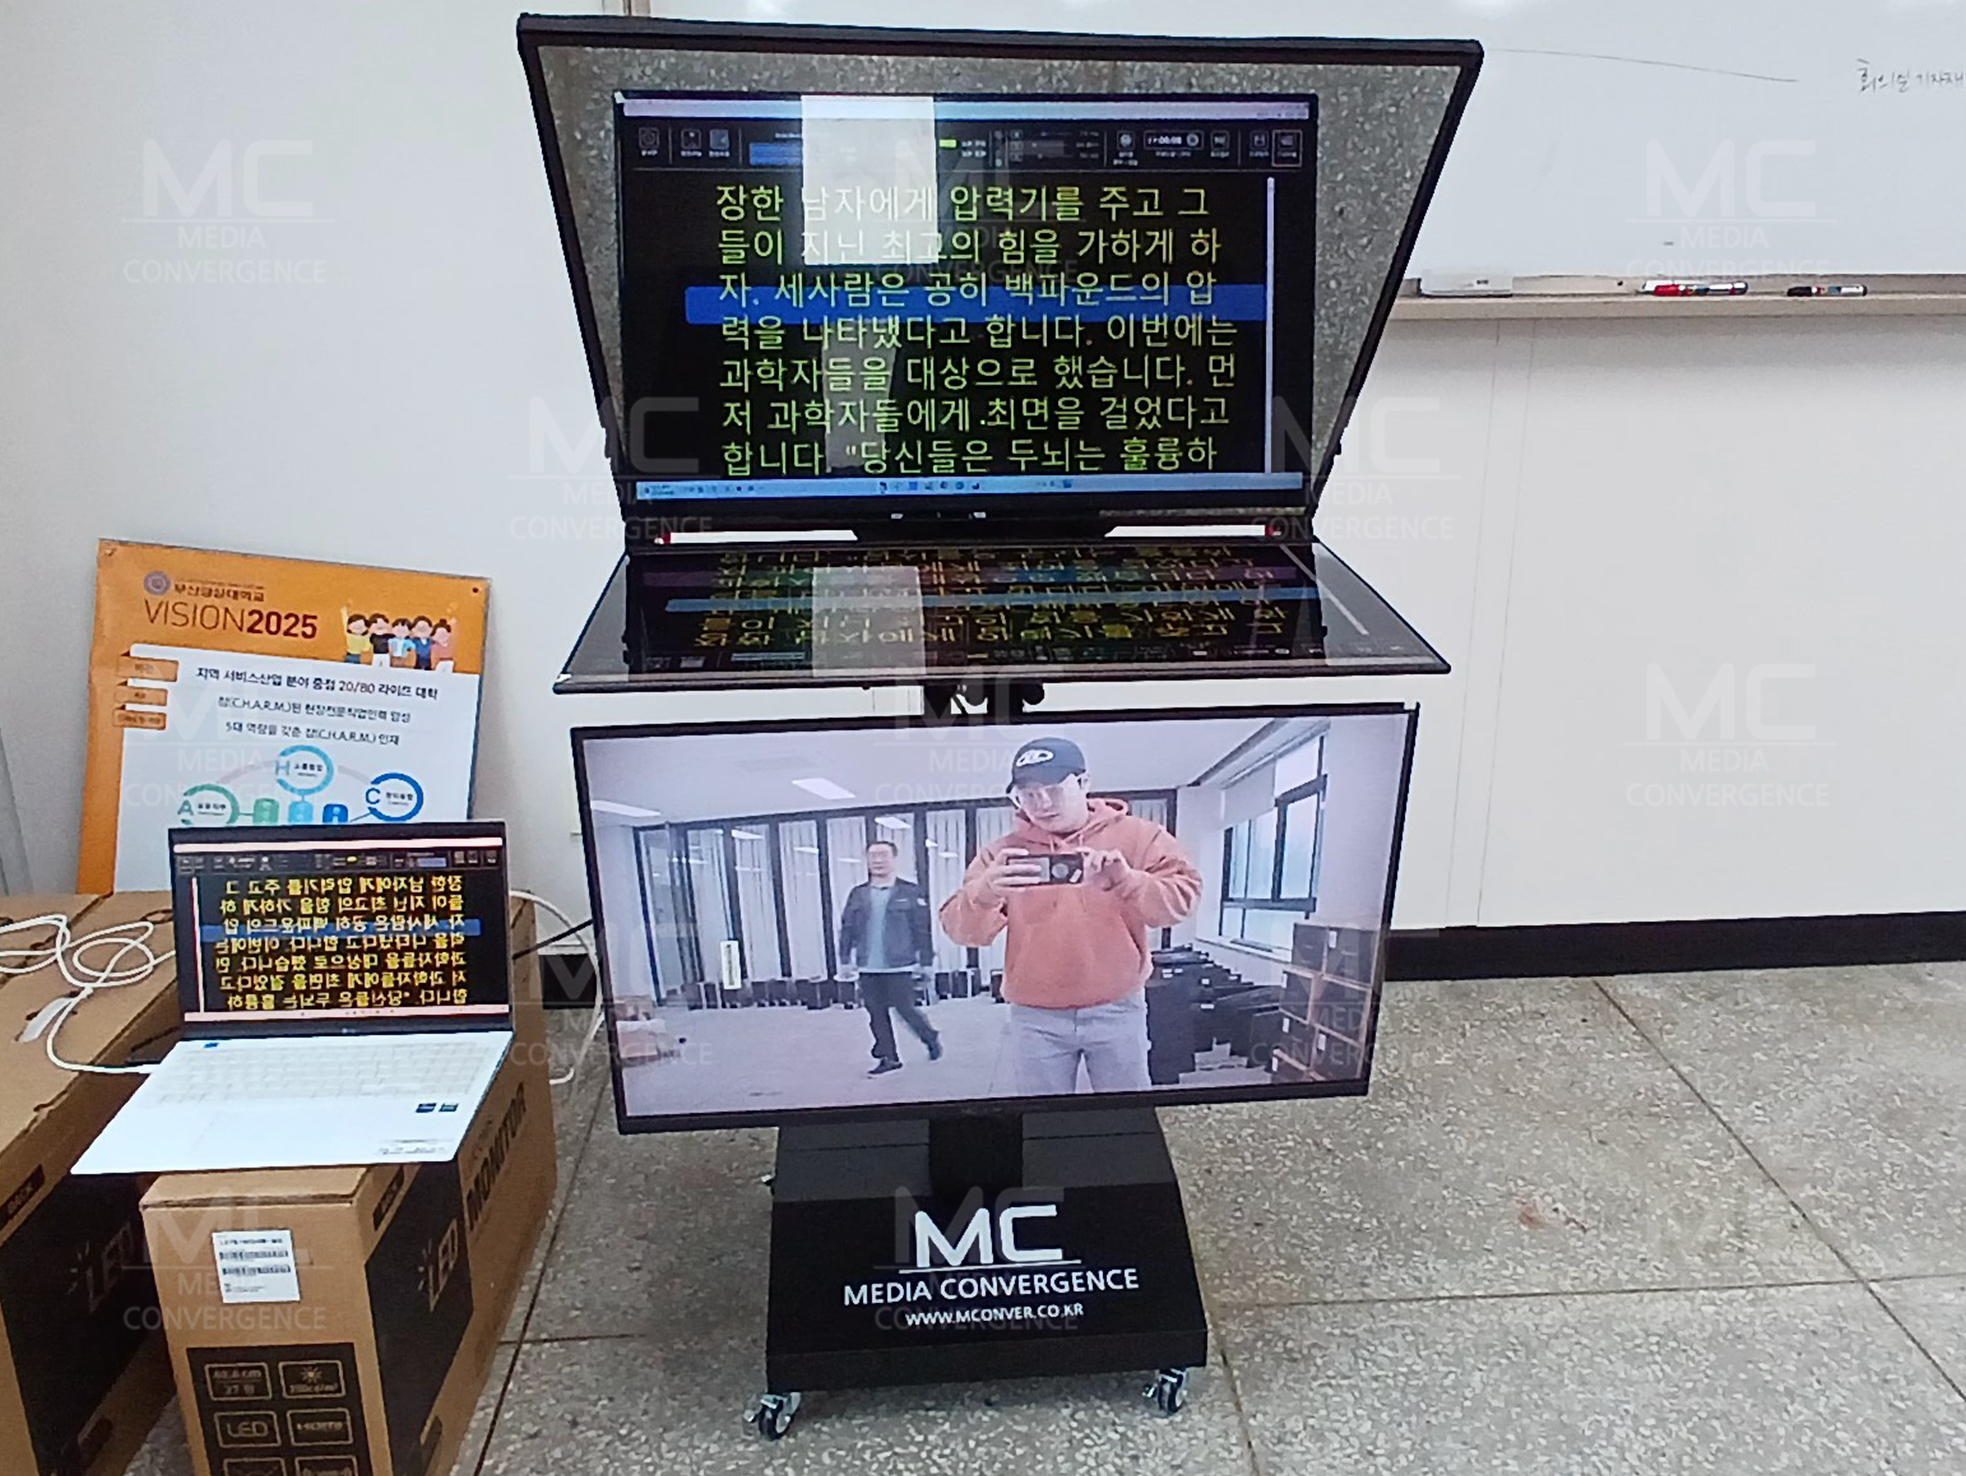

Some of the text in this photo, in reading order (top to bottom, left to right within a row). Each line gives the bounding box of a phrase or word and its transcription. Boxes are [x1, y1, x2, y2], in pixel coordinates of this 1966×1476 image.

[717, 185, 785, 221] 장한
[950, 186, 1084, 222] 압력기를
[1099, 186, 1163, 222] 주고
[1179, 189, 1208, 215] 그
[718, 228, 783, 265] 들이
[998, 229, 1060, 265] 힘을
[1078, 228, 1173, 264] 가하게
[1191, 227, 1220, 263] 하
[775, 272, 910, 308] 세사람은
[924, 271, 986, 307] 공히
[1005, 271, 1169, 307] 백파운드의
[1186, 271, 1217, 305] 압
[722, 315, 785, 351] 력을
[1107, 313, 1237, 348] 이번에는
[719, 356, 893, 396] 과학자들을
[907, 356, 1038, 391] 대상으로
[1209, 353, 1234, 387] 먼
[723, 397, 1229, 438] 저 과학자들에게 최면을 걸었다고
[1008, 439, 1111, 477] 두뇌는
[224, 670, 283, 687] 서비스산업
[338, 680, 376, 694] 20/80
[914, 1204, 1063, 1268] MC
[843, 1281, 933, 1306] MEDIA
[940, 1268, 1139, 1300] CONVERGENCE
[904, 1302, 1085, 1327] WWW.MCONVER.CO.KR
[226, 1421, 269, 1438] LED
